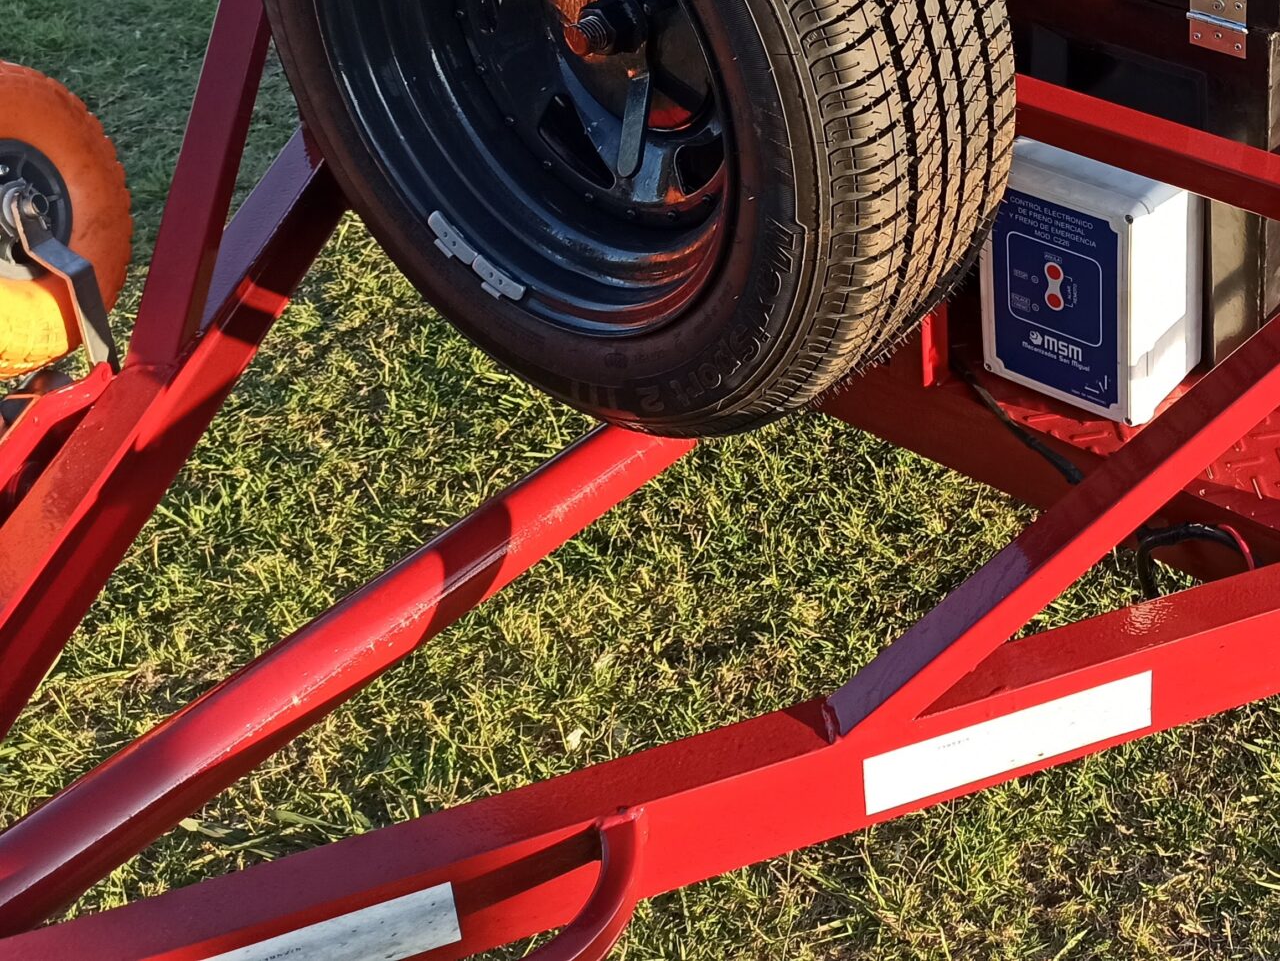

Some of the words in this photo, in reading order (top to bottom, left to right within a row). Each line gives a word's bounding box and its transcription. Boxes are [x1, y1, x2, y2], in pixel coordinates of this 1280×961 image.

[1009, 196, 1043, 213] CONTROL
[1043, 207, 1094, 230] ELECTRONICO
[1018, 207, 1028, 215] DE
[1028, 210, 1053, 224] FRENO
[1053, 219, 1086, 236] INERCIAL
[1014, 214, 1039, 228] FRENO
[1039, 222, 1050, 232] DE
[1050, 226, 1097, 248] EMERGENCIA
[1058, 355, 1070, 365] San
[634, 386, 665, 413] 2
